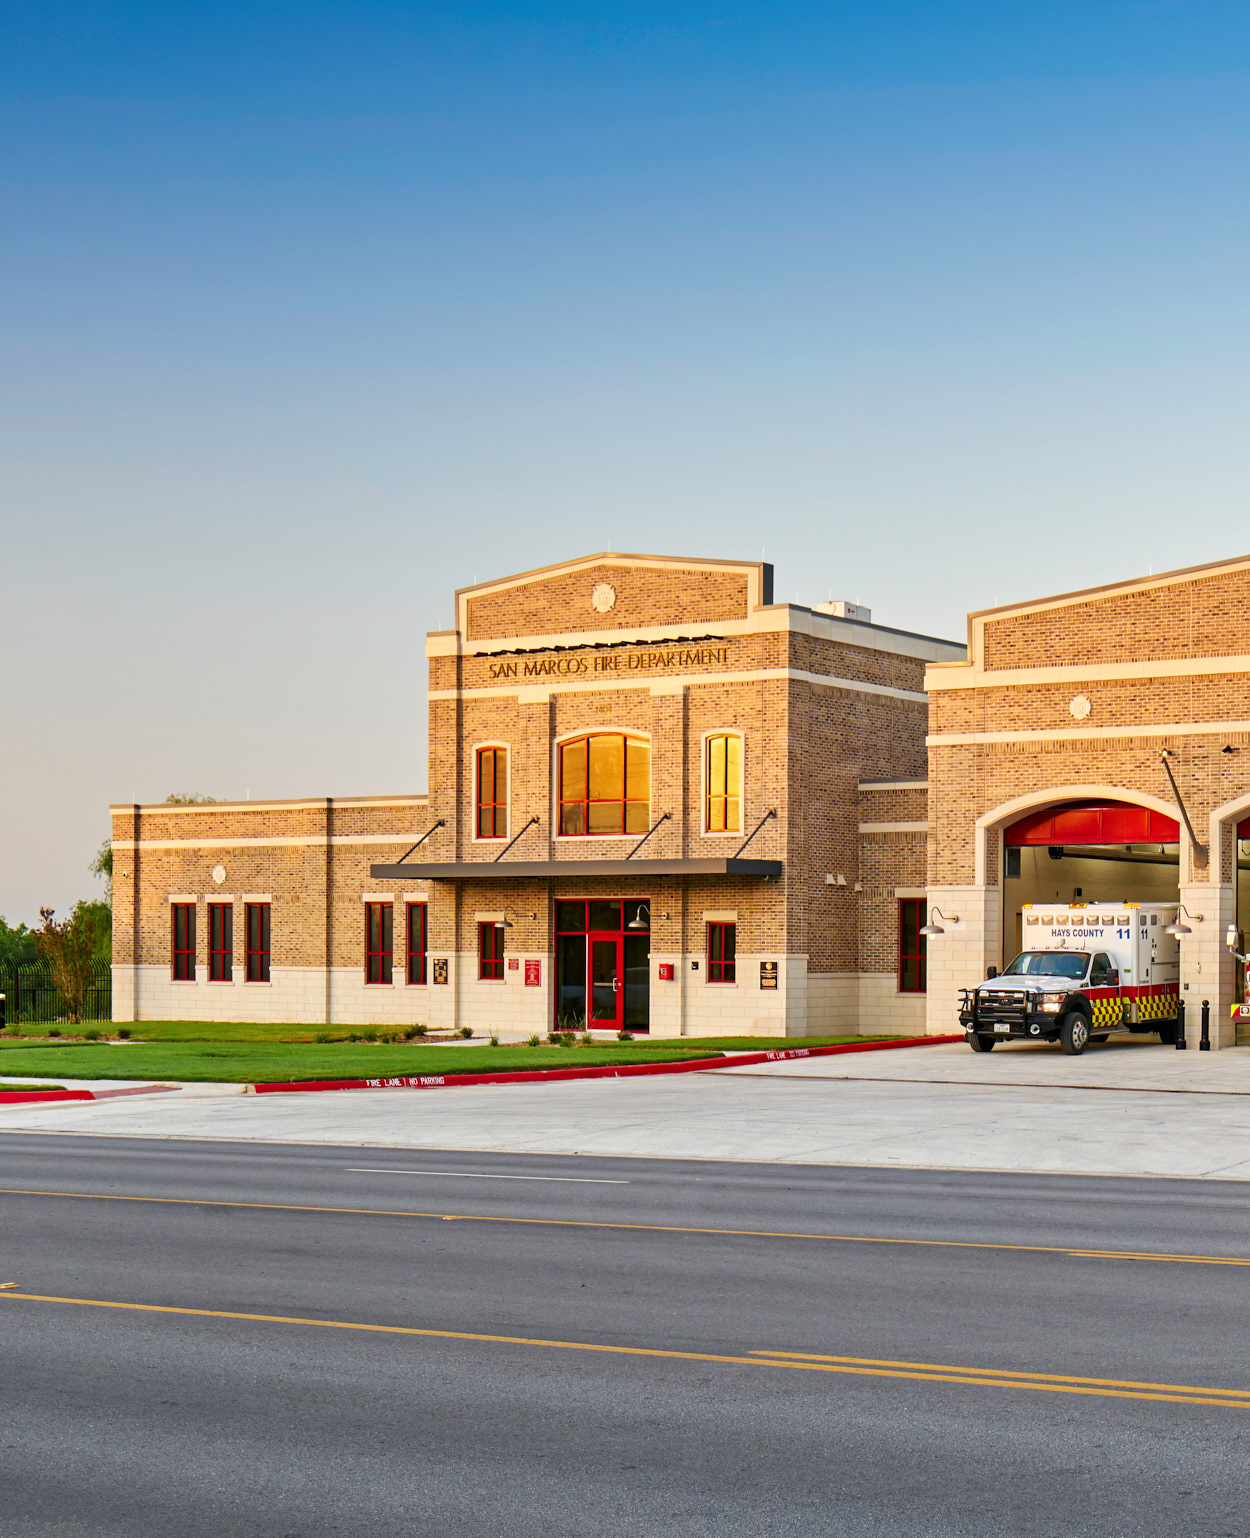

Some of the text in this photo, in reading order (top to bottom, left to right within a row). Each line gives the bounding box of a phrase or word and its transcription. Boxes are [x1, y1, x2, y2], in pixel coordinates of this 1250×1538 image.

[489, 647, 729, 678] SAN MARCOS FIRE DEPARTMENT
[1051, 929, 1104, 937] HAYS COUNTY
[1117, 929, 1130, 939] 11
[1141, 929, 1148, 939] 11
[384, 1078, 402, 1086] LANE
[420, 1077, 444, 1085] PARKING
